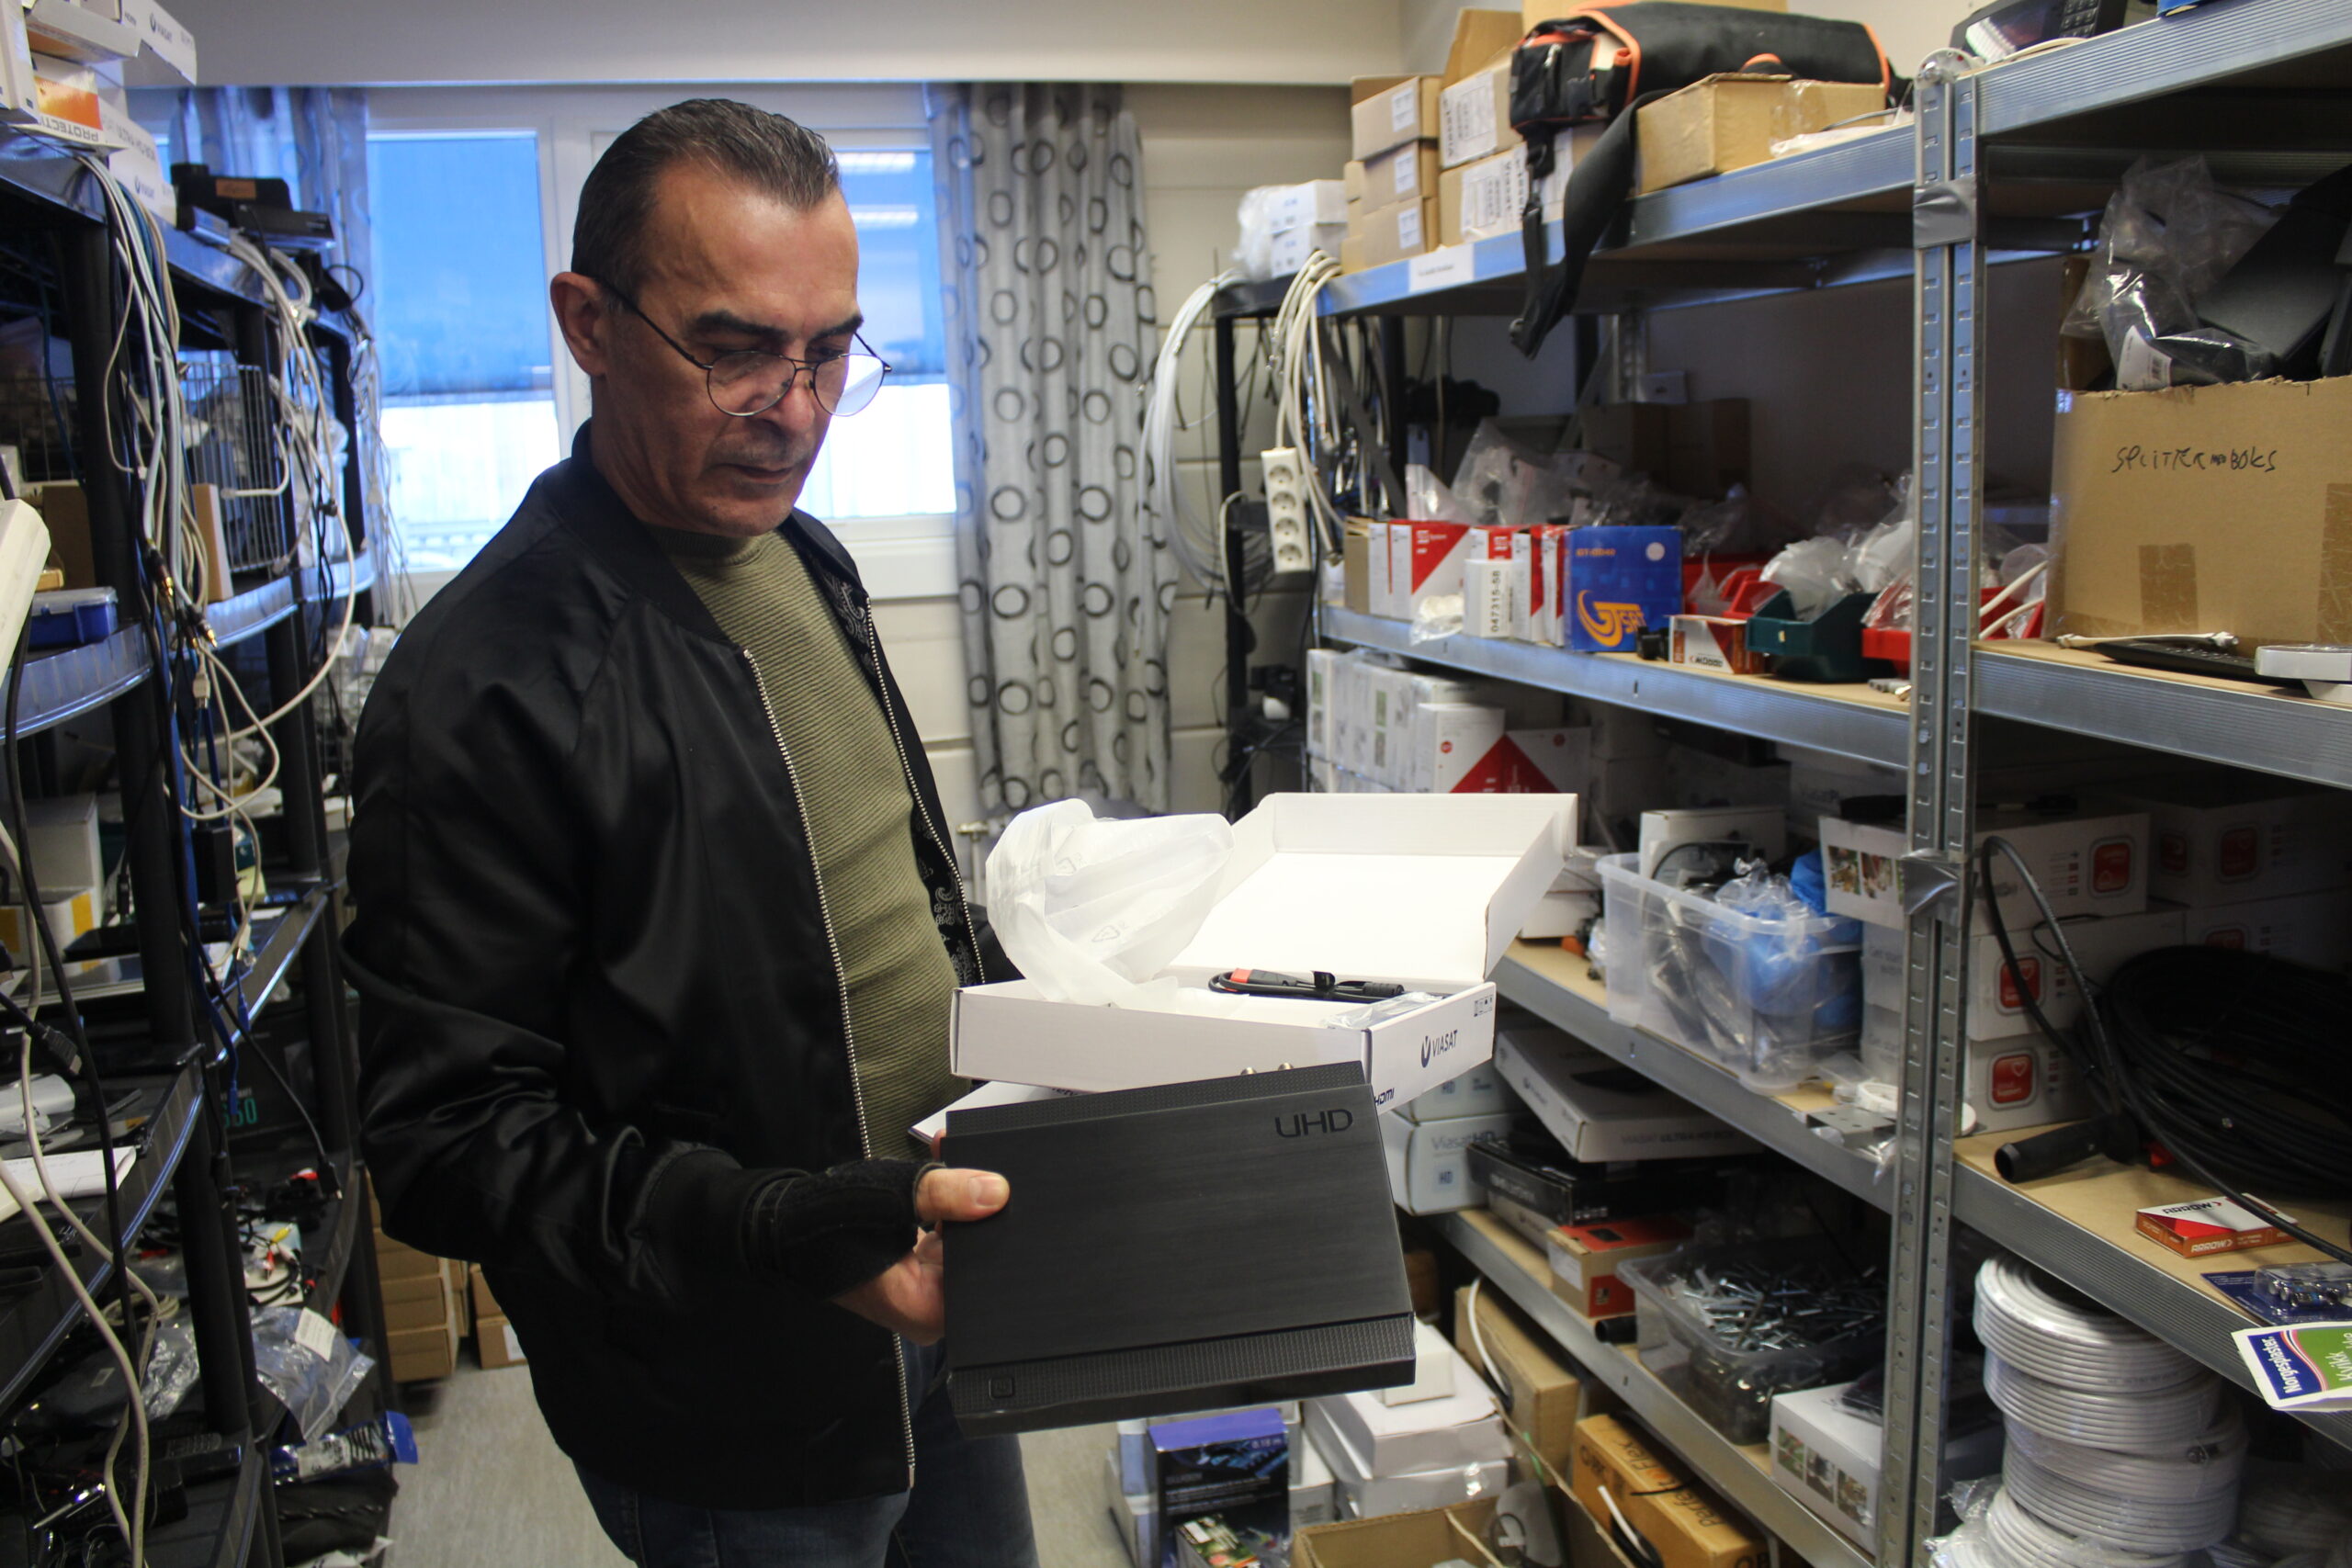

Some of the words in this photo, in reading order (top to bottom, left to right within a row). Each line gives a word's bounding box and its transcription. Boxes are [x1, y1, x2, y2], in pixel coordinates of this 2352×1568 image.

[1432, 1029, 1458, 1058] VIASAT
[1274, 1109, 1353, 1138] UHD
[2163, 1201, 2212, 1214] ARROW
[2190, 1239, 2227, 1253] ARROW
